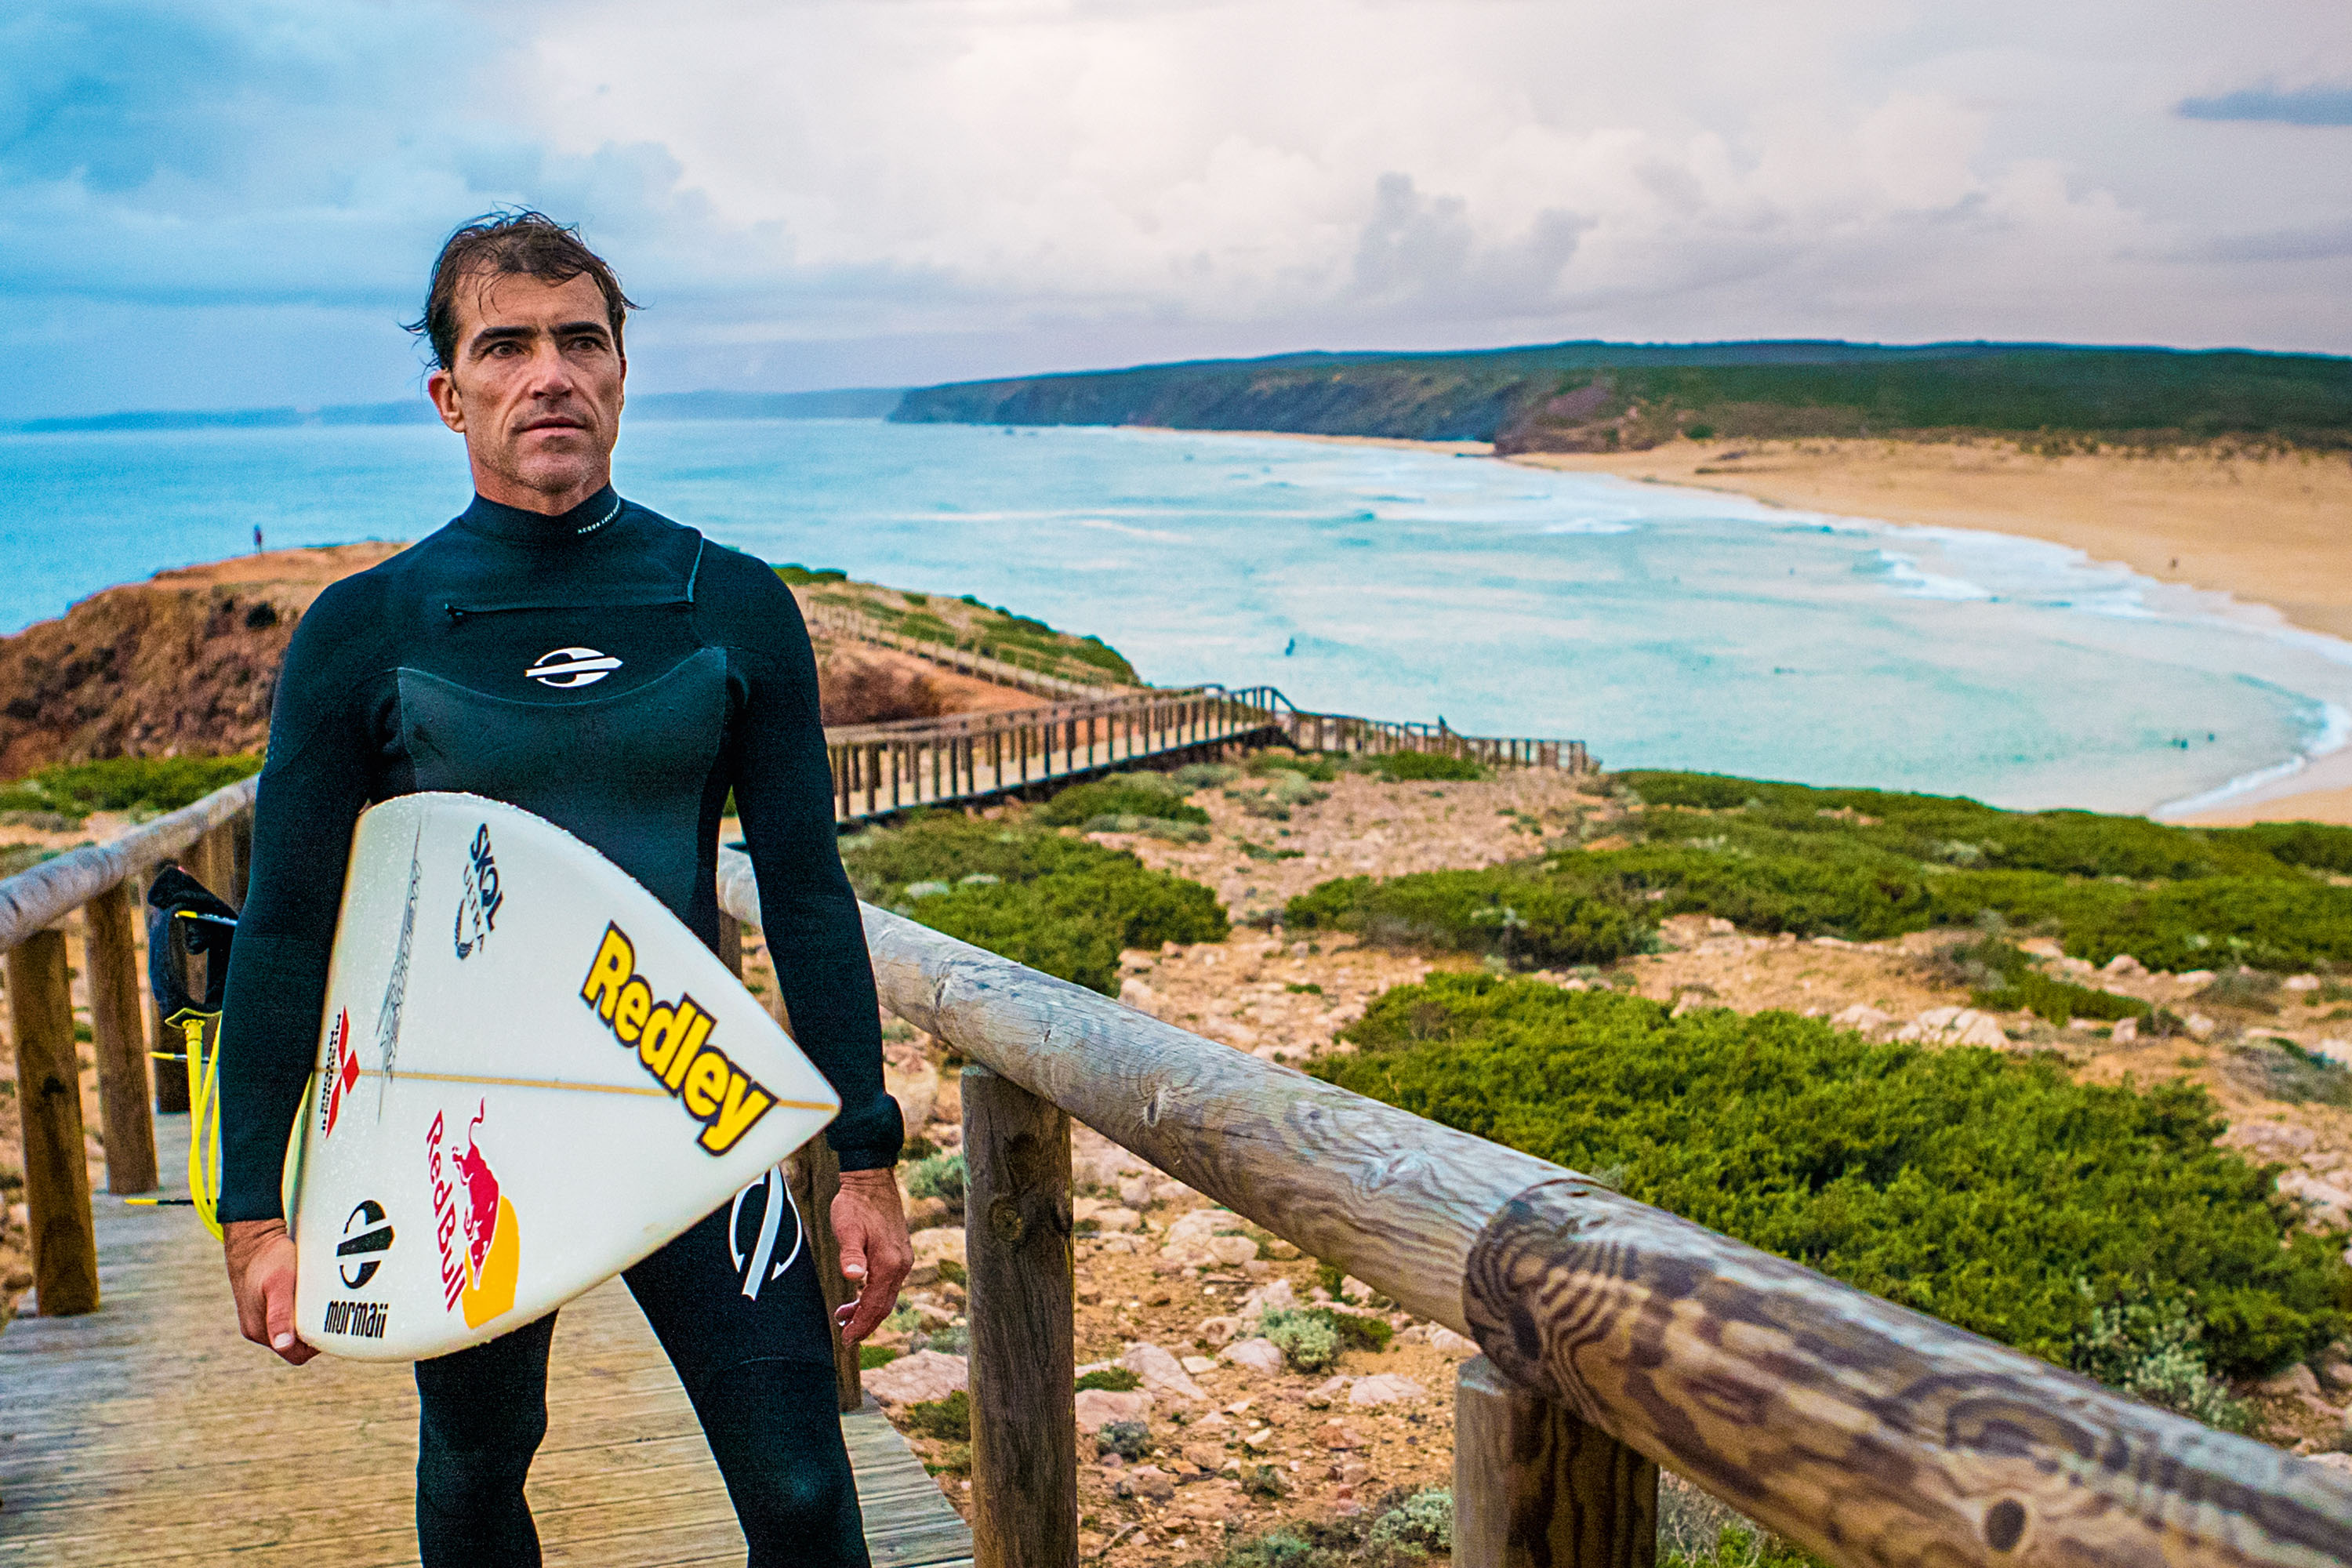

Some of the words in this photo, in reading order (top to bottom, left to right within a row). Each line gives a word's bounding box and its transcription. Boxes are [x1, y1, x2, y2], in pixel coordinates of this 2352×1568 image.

[470, 822, 504, 932] SKOL
[320, 1029, 336, 1114] MOTORS
[321, 1013, 342, 1131] MITSUBISHI
[579, 920, 780, 1157] Redley
[323, 1300, 389, 1339] mormaii
